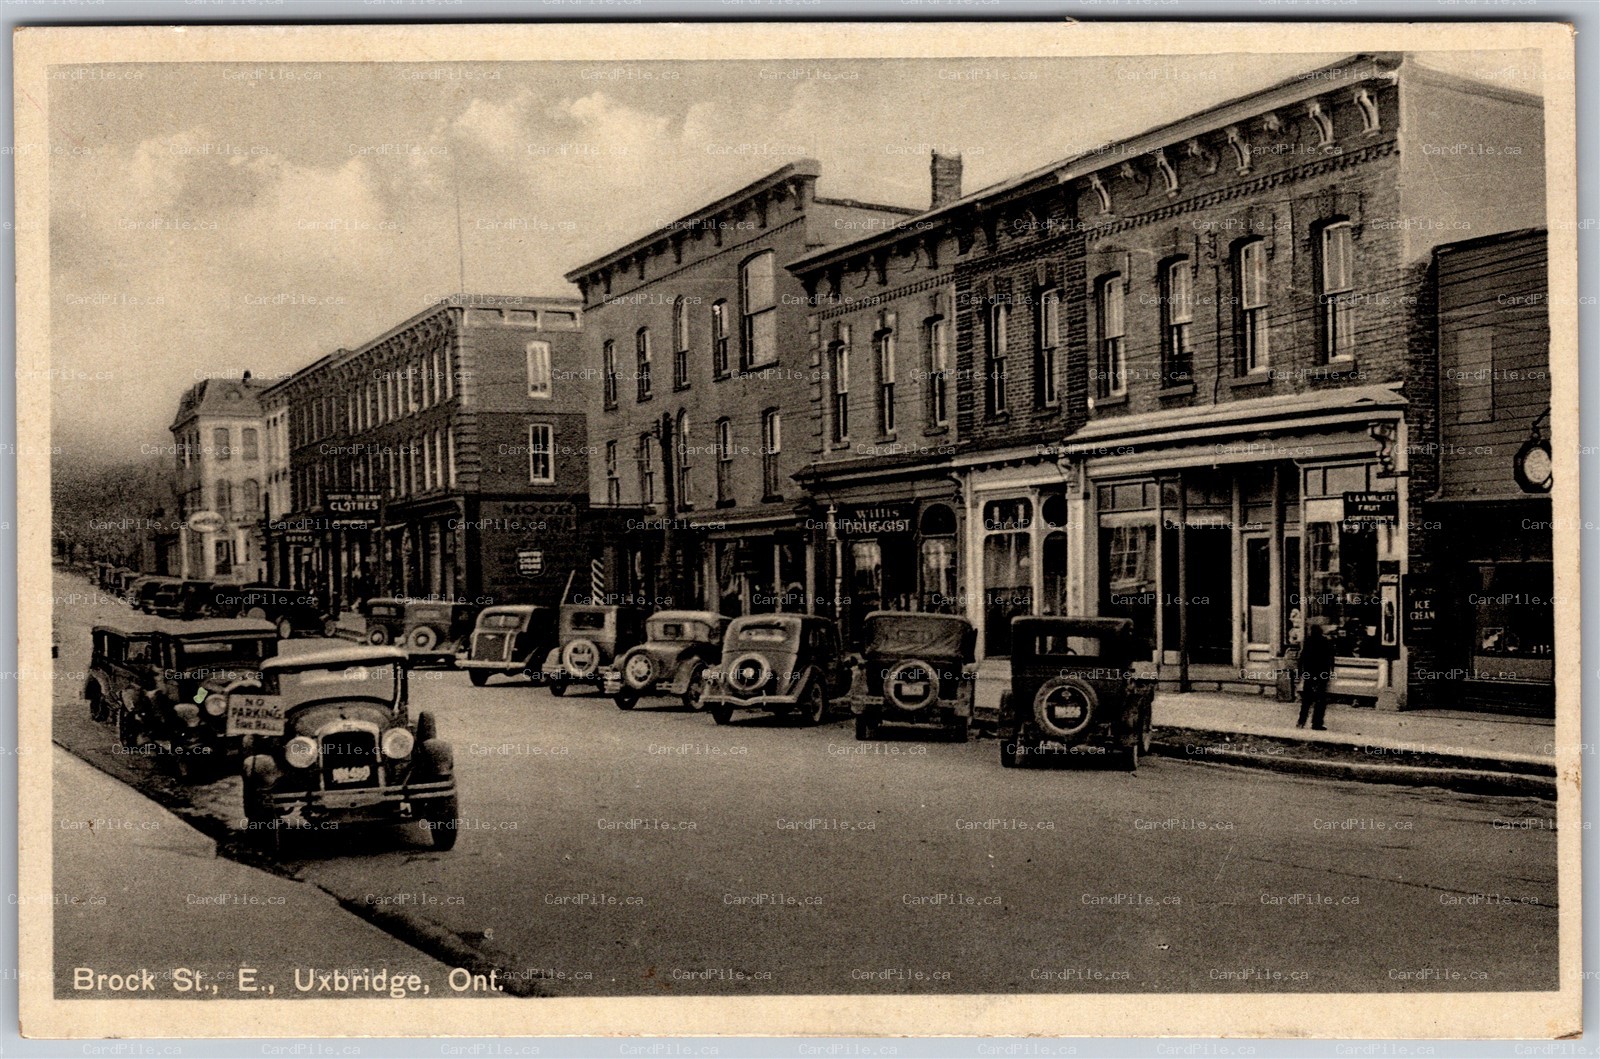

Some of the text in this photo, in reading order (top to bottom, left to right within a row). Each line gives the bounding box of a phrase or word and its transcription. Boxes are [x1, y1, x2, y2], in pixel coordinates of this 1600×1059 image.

[1347, 494, 1396, 503] L & A WALKER
[329, 501, 379, 513] CLOTHES
[1357, 504, 1381, 512] FRUIT
[845, 519, 911, 535] DRUGGIST
[1414, 600, 1431, 609] ICE
[1409, 610, 1435, 620] CREAM
[245, 698, 265, 706] NO
[231, 707, 283, 720] PARKING
